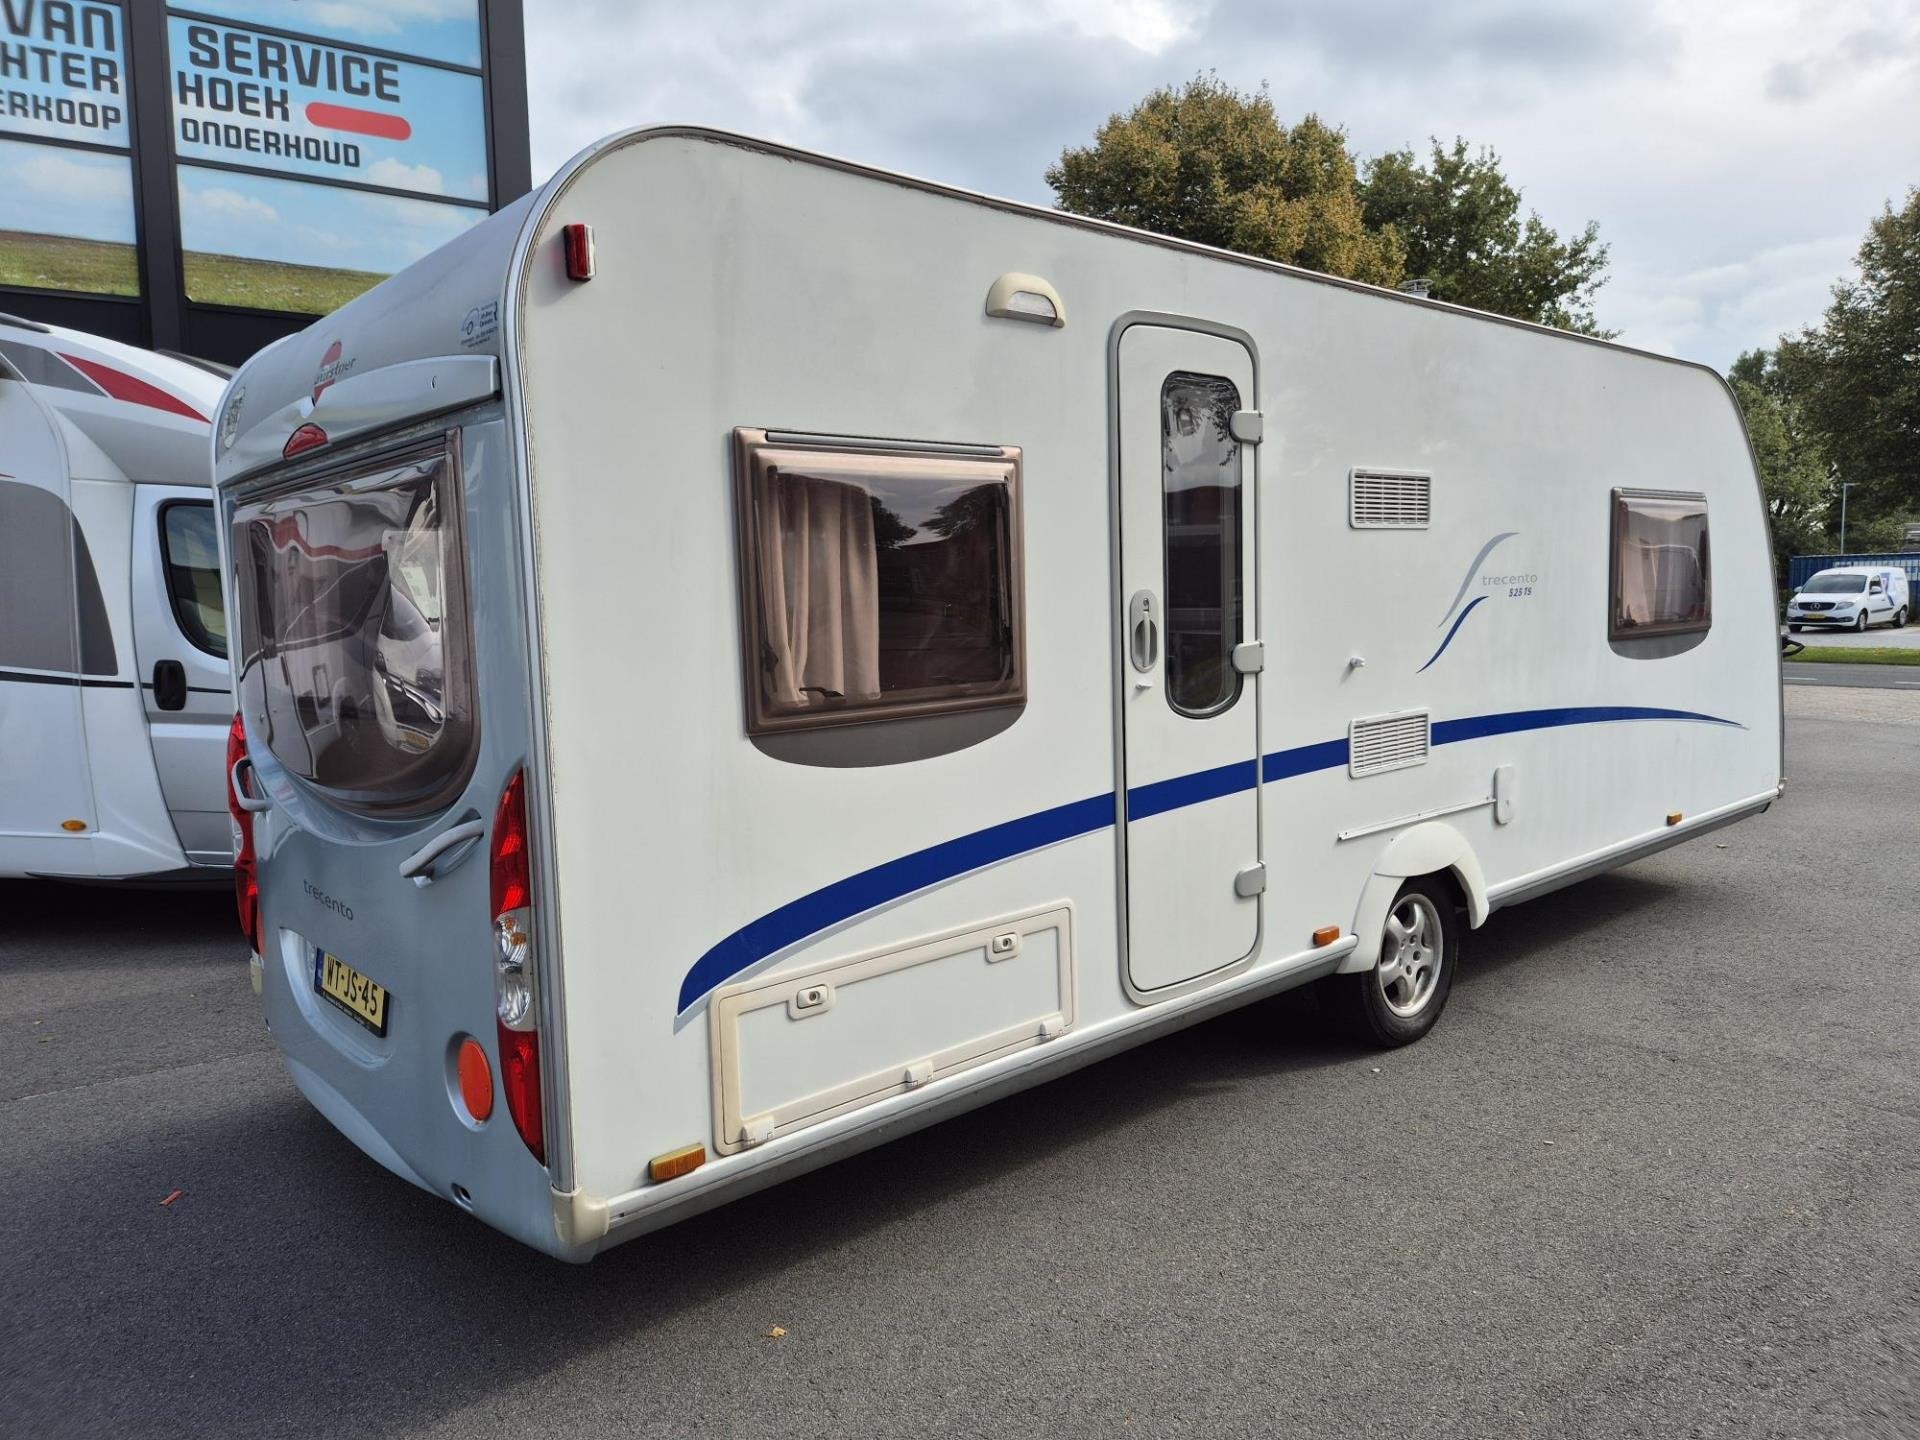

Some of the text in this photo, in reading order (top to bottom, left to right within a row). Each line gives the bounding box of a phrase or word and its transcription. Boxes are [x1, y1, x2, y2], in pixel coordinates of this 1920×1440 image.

[188, 25, 400, 103] SERVICE
[0, 88, 121, 130] RKOOP
[177, 71, 290, 123] HOEK
[181, 117, 361, 168] ONDERHOUD
[1482, 574, 1538, 586] trecento
[1509, 587, 1523, 598] 525
[303, 879, 355, 921] trecento
[327, 955, 379, 1016] WT-JS-45
